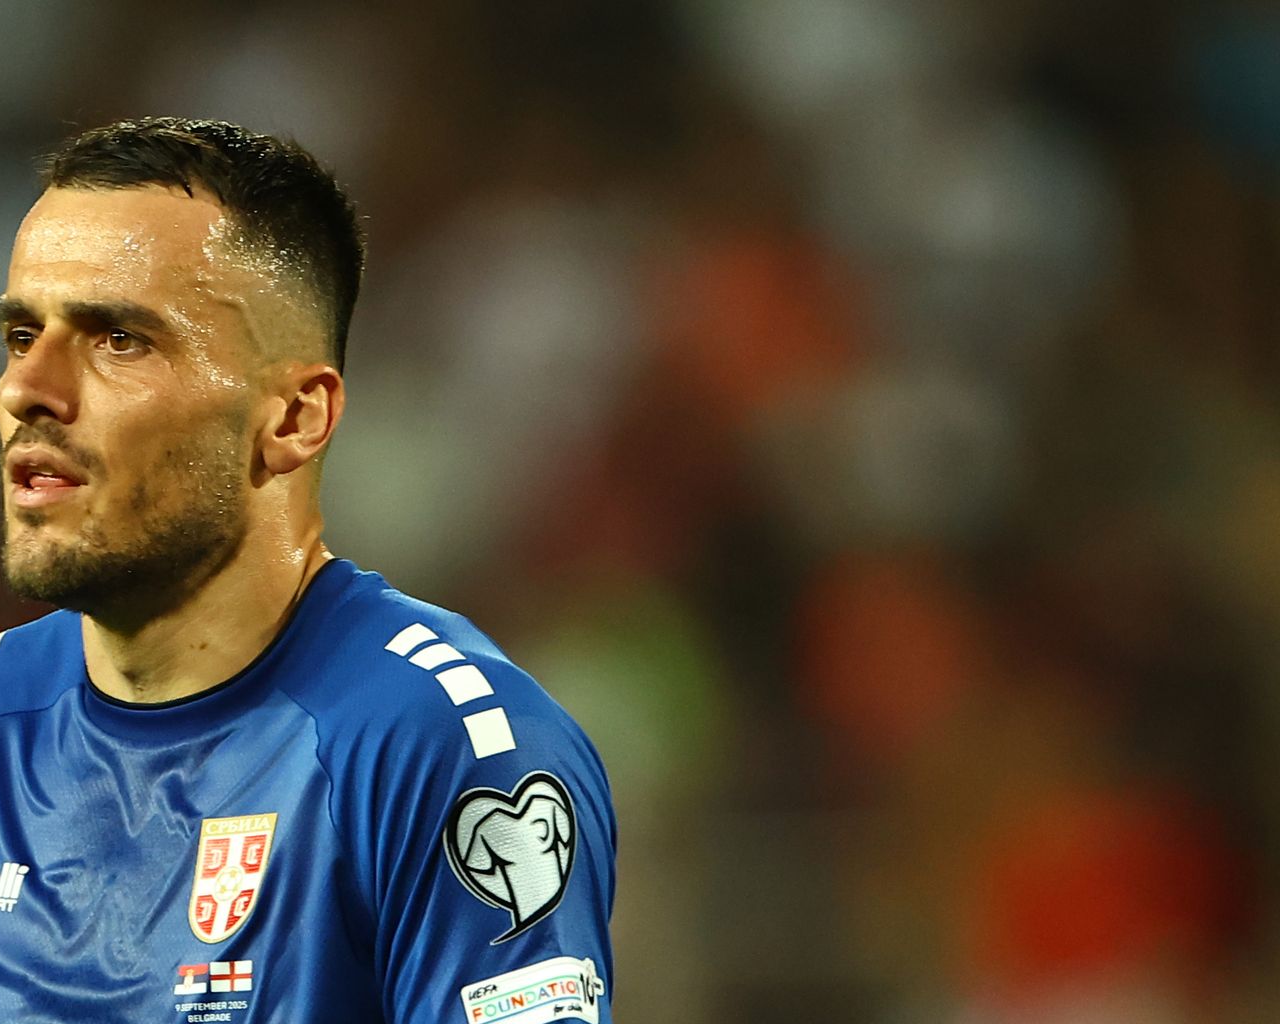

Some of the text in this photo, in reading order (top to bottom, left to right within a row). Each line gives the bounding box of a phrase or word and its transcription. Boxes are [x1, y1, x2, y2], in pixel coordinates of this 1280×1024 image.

[468, 984, 498, 1001] UEFA
[180, 1001, 228, 1012] SEPTEMBER
[228, 1000, 248, 1010] 2025
[187, 1012, 232, 1023] BELGRADE
